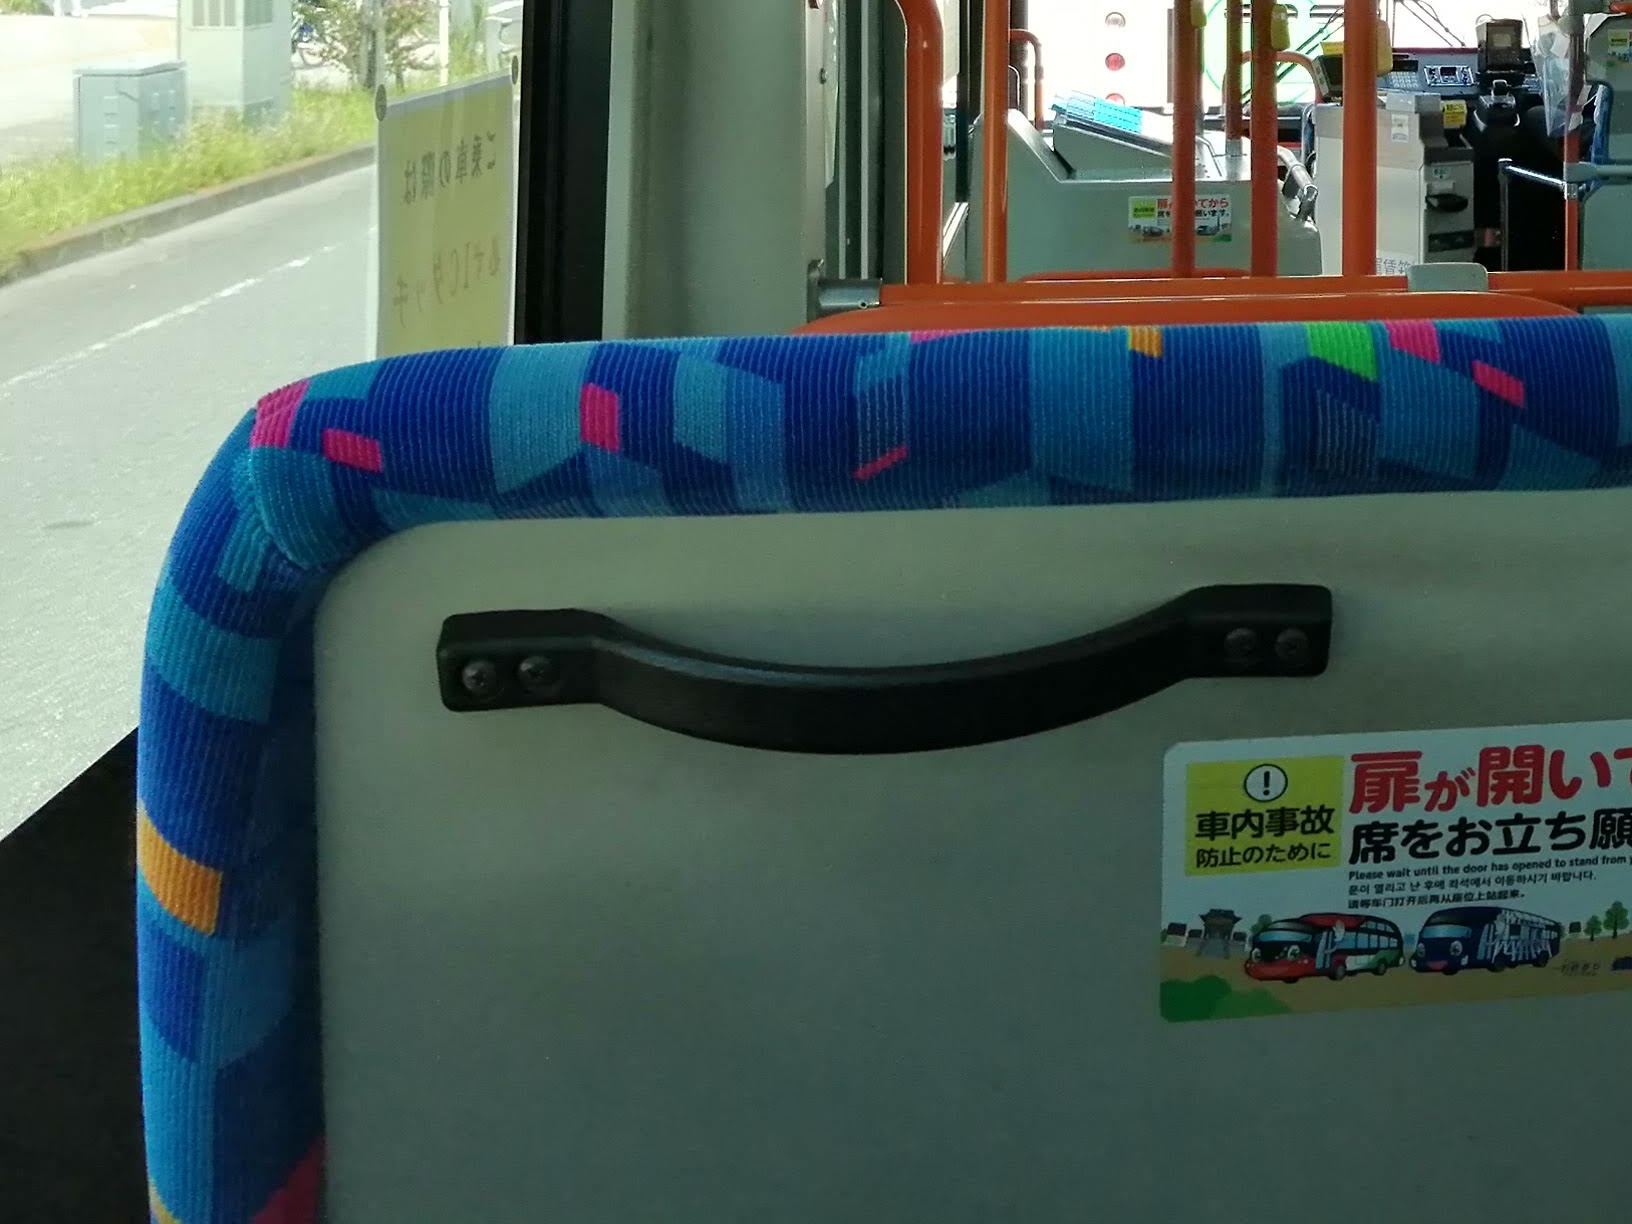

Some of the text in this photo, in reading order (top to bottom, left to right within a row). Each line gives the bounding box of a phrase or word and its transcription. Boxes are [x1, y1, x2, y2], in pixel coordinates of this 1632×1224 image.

[1195, 803, 1335, 842] 車内事故
[1196, 841, 1331, 870] 防止のために
[1348, 869, 1383, 881] Please
[1386, 868, 1410, 878] wait
[1414, 866, 1439, 877] until
[1442, 865, 1460, 874] the
[1463, 863, 1488, 874] door
[1491, 862, 1509, 871] has
[1512, 858, 1552, 872] opened
[1555, 859, 1566, 867] to
[1569, 856, 1598, 867] stand
[1602, 855, 1626, 865] from
